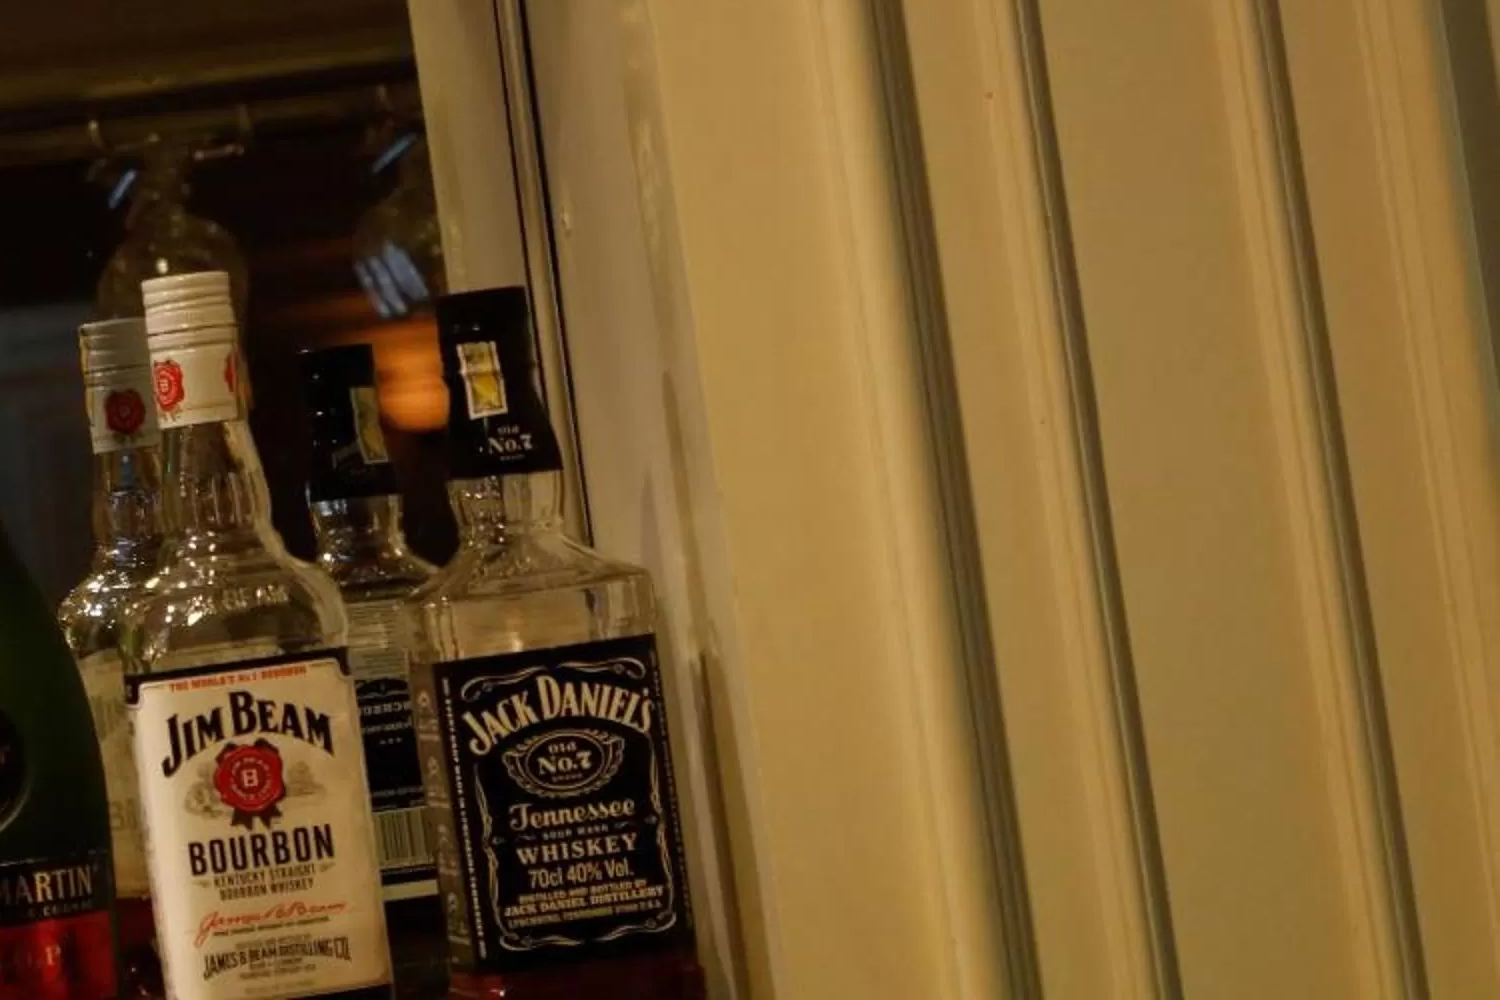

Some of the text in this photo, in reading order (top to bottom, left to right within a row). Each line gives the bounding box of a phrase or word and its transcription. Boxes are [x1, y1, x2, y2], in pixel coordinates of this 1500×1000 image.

[488, 433, 532, 455] No.7
[461, 674, 653, 757] JACK DANIEL'S
[162, 691, 334, 778] JIM BEAM
[242, 769, 259, 787] B
[536, 750, 593, 776] No.7
[508, 797, 636, 831] Tennessee
[187, 823, 335, 877] BOURBON
[516, 831, 637, 866] WHISKEY
[528, 856, 636, 890] 70cl 40% Vol.
